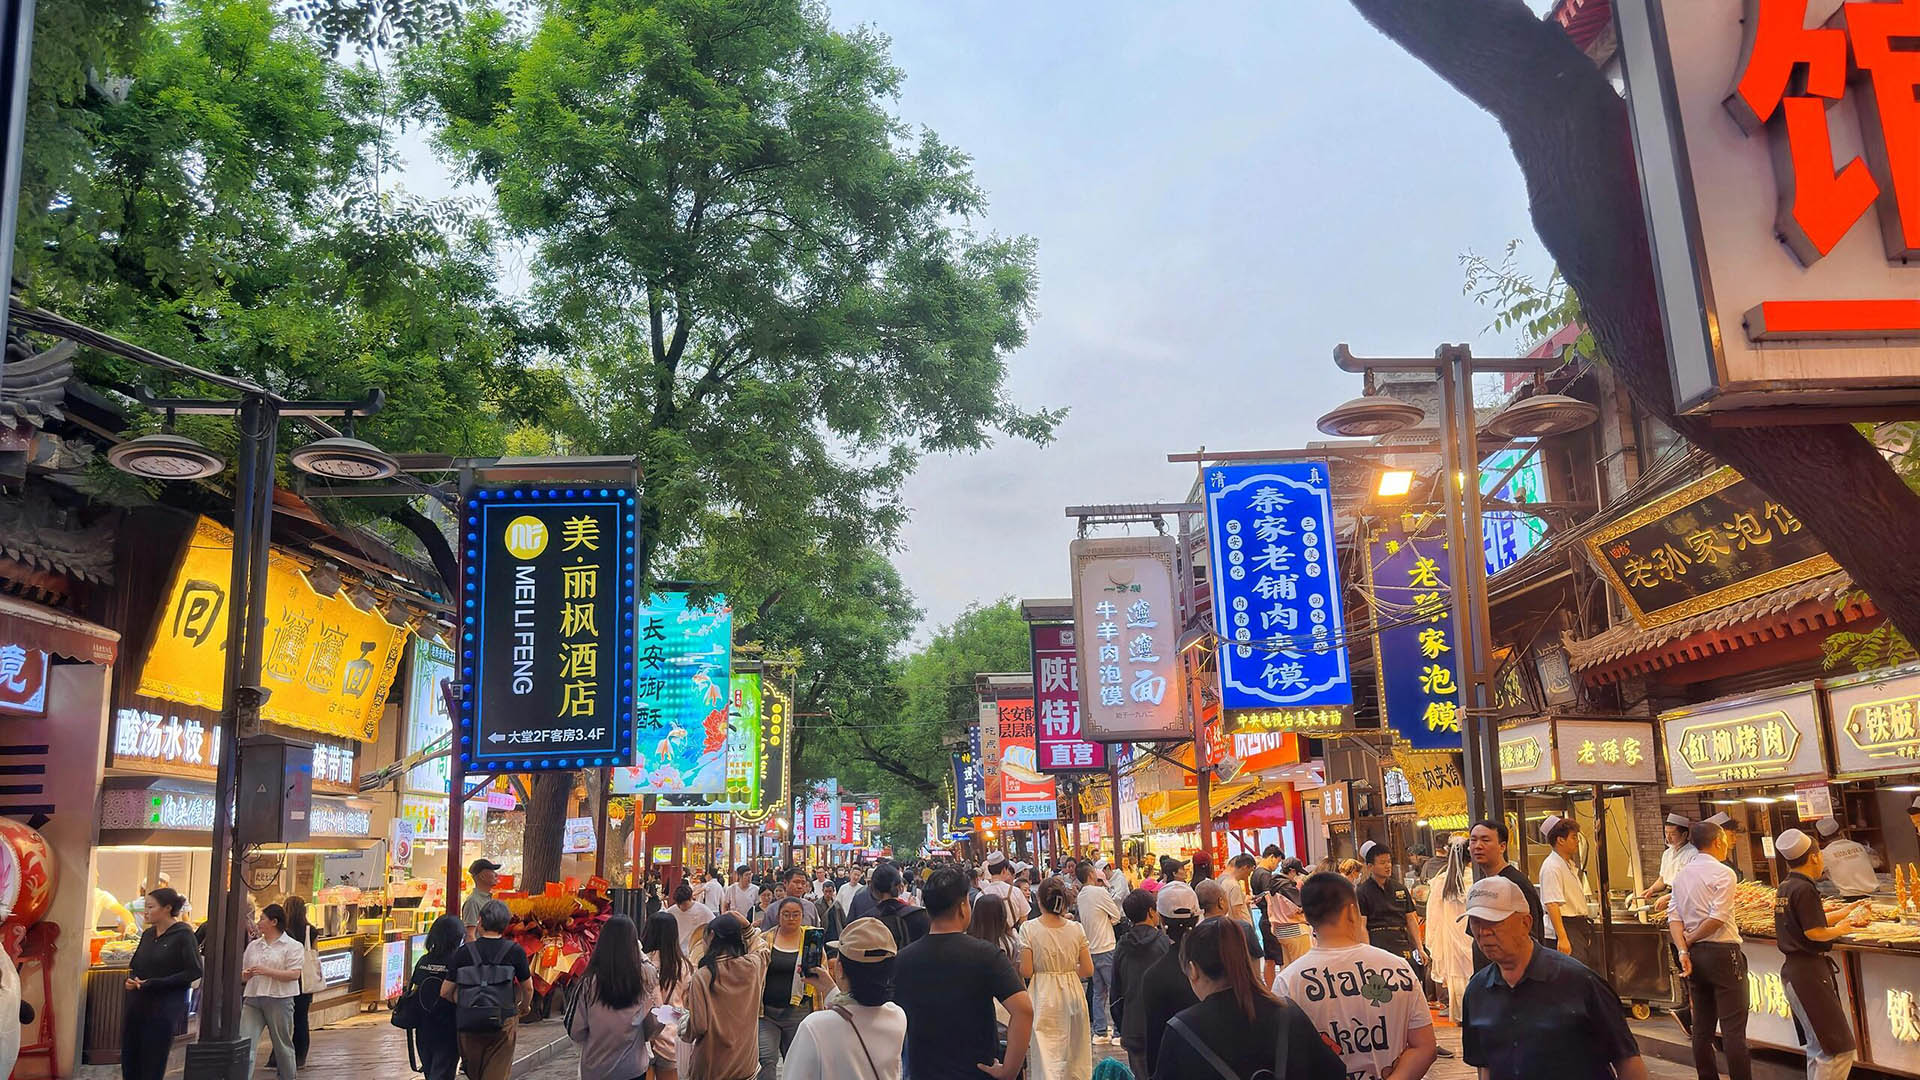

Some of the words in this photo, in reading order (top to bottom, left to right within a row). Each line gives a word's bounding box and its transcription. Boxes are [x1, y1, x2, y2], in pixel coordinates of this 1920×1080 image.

[1210, 471, 1226, 488] 清
[1307, 467, 1323, 484] 真
[1227, 520, 1245, 579] 西安名吃
[515, 566, 536, 605] MEI
[1246, 485, 1310, 690] 秦家老铺肉夹馍
[514, 609, 535, 627] LI
[512, 631, 535, 695] FENG
[1096, 600, 1125, 706] 牛羊肉泡馍
[114, 708, 204, 765] 酸汤水饺
[1237, 711, 1342, 729] 中央电视台美食专访
[1051, 744, 1094, 766] 直营
